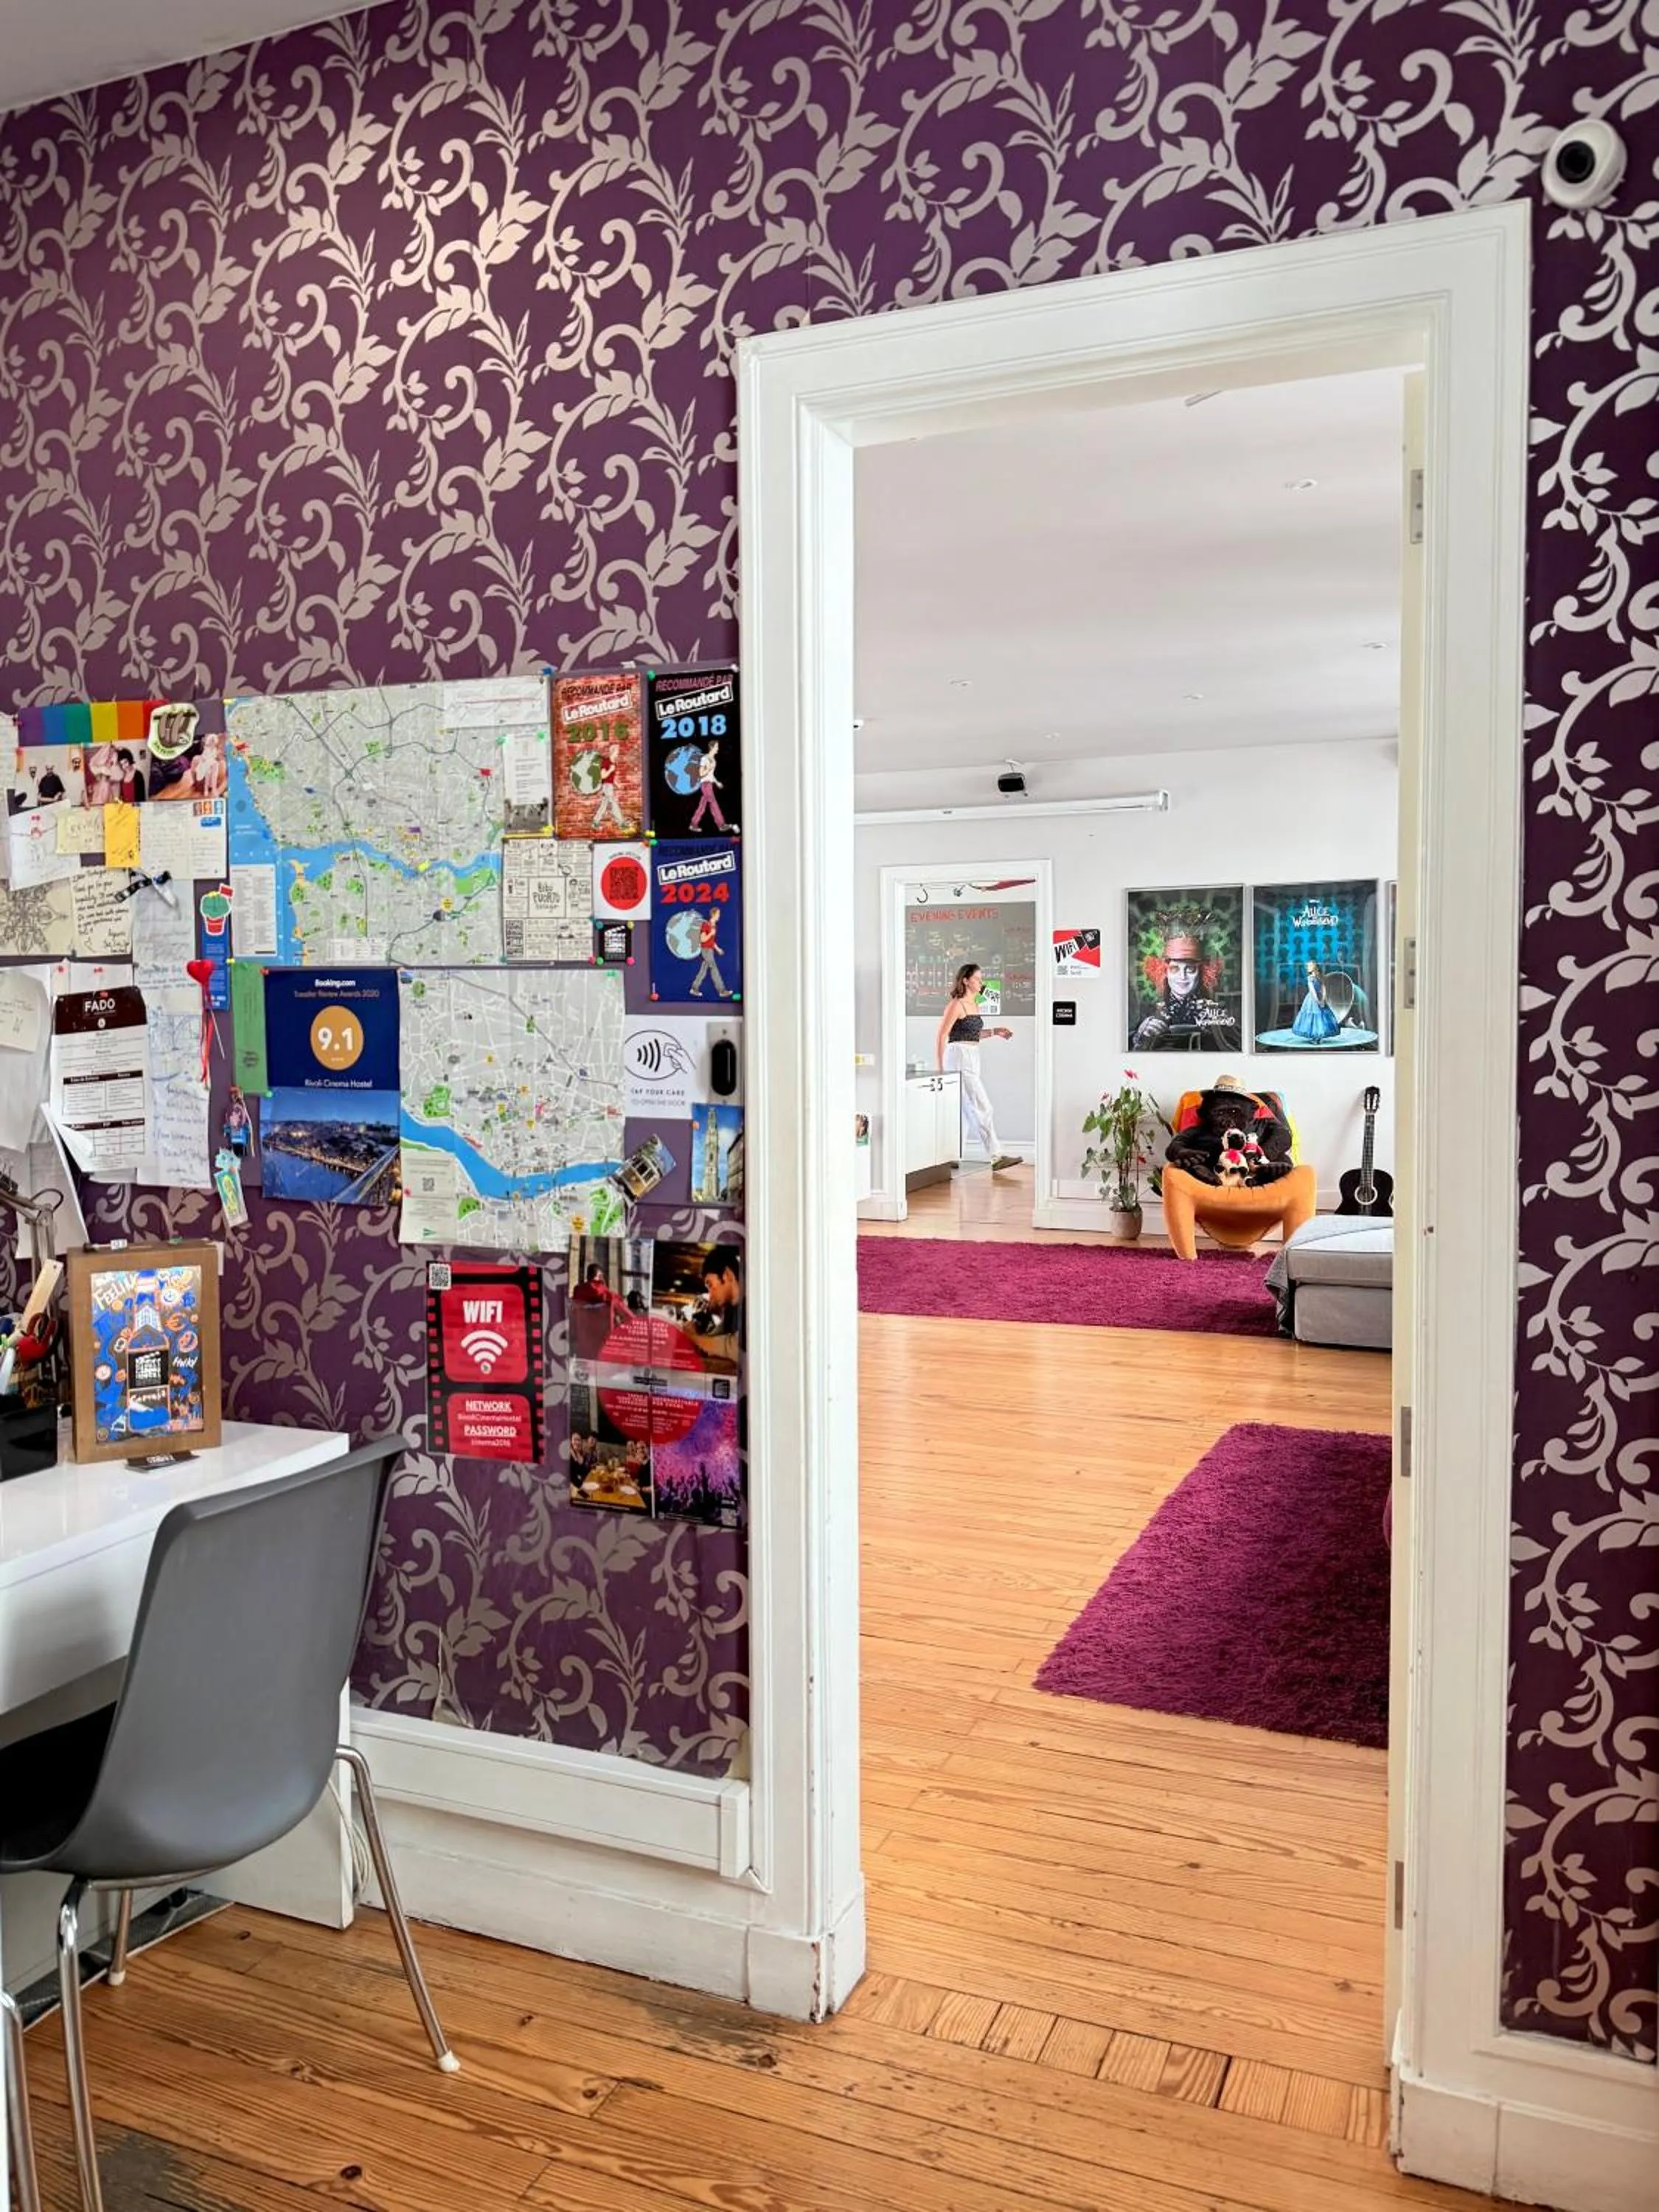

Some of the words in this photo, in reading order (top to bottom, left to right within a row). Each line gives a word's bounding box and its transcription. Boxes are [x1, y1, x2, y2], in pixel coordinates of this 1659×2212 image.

[564, 706, 579, 721] Le
[579, 692, 630, 717] Routard
[658, 703, 675, 717] Le
[675, 686, 730, 712] Routard
[567, 722, 628, 742] 2016
[661, 714, 727, 740] 2018
[661, 867, 677, 881] Le
[677, 855, 732, 878] Routard
[660, 882, 730, 903] 2024
[315, 978, 356, 989] Booking.com
[84, 998, 116, 1012] FADO
[318, 1026, 355, 1051] 9.1
[350, 1079, 373, 1088] Hostel
[462, 1299, 504, 1324] WIFI
[465, 1399, 512, 1413] NETWORK
[464, 1424, 518, 1438] PASSWORD
